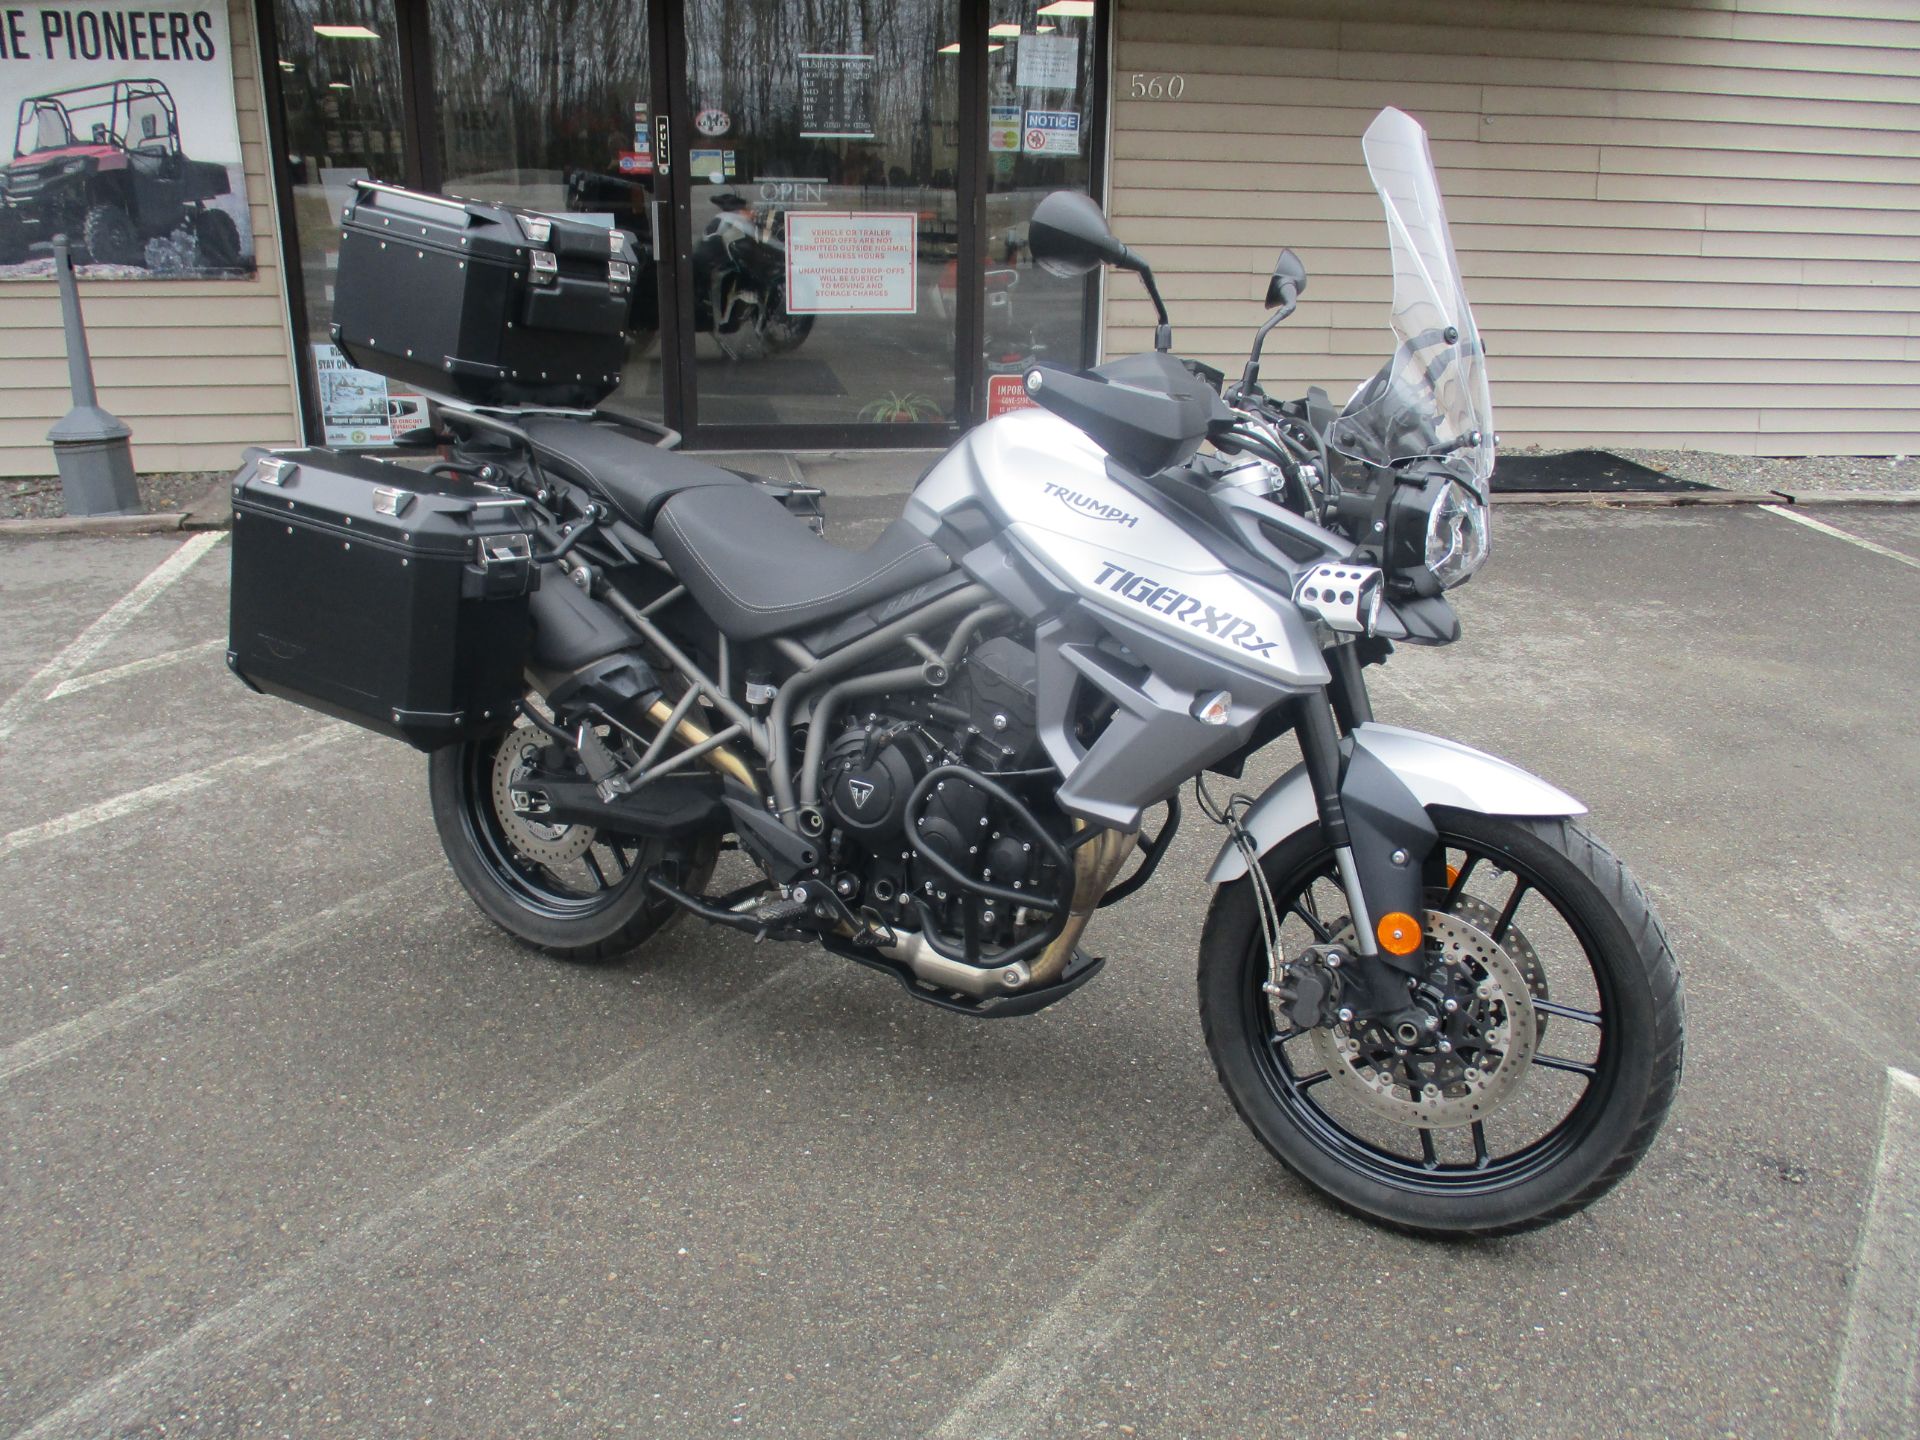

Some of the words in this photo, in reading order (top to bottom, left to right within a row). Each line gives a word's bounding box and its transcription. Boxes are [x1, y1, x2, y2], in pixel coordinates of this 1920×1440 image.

[41, 10, 215, 61] PIONEERS
[801, 60, 838, 69] BUSINESS
[841, 61, 871, 69] HOURS
[1131, 74, 1184, 99] 560
[1028, 114, 1076, 129] NOTICE
[659, 123, 667, 159] PULL
[760, 183, 822, 201] OPEN
[318, 360, 334, 369] STAY
[1043, 482, 1139, 528] TRIUMPH
